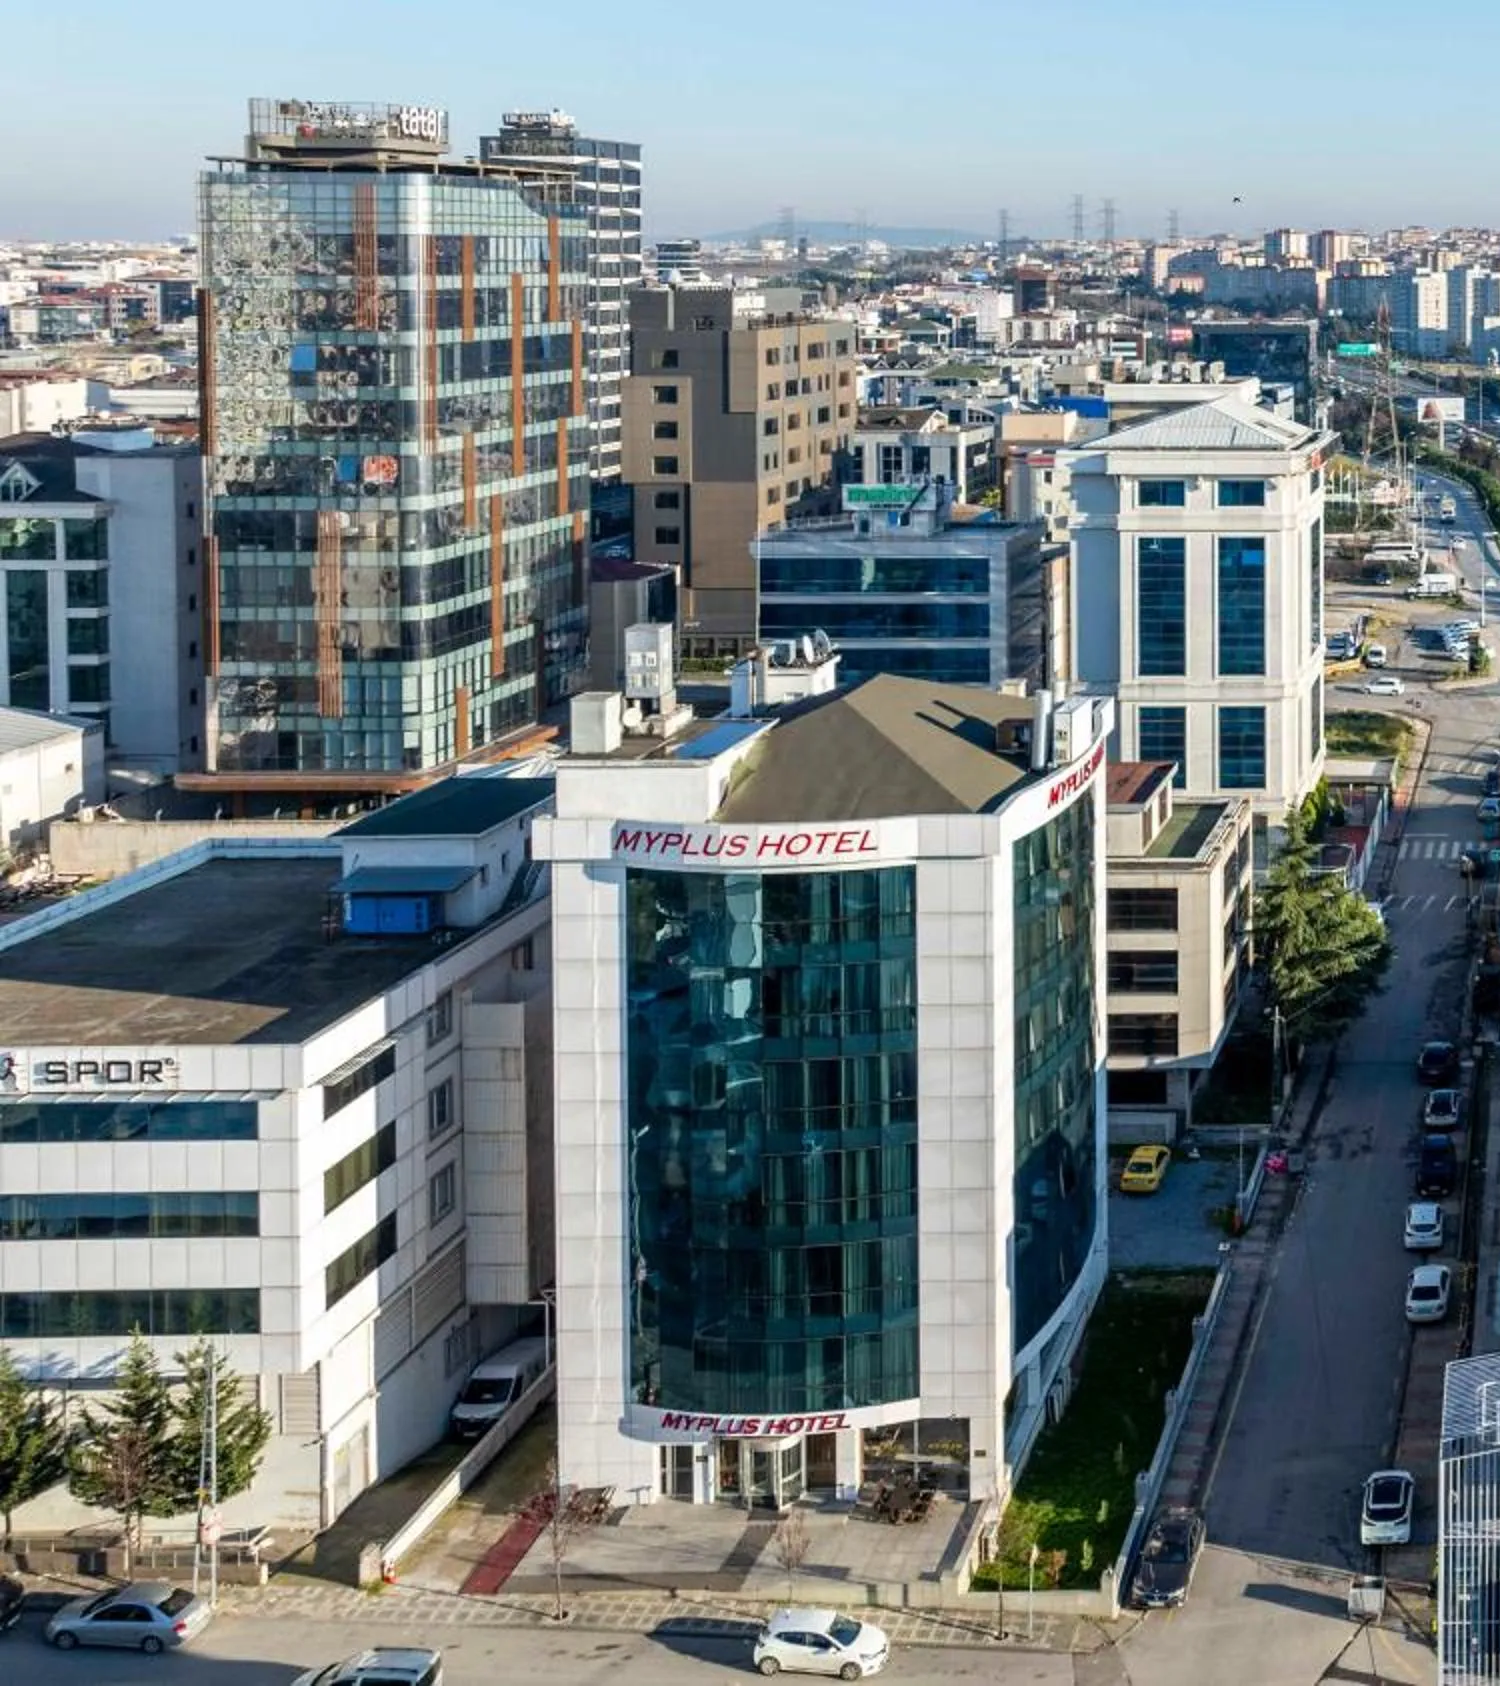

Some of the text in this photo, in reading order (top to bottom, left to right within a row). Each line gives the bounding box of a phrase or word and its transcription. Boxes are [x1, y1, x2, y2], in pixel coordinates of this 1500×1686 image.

[614, 829, 879, 858] MYPLUS HOTEL
[45, 1060, 163, 1083] SPOR
[661, 1412, 851, 1435] MYPLUS HOTEL
